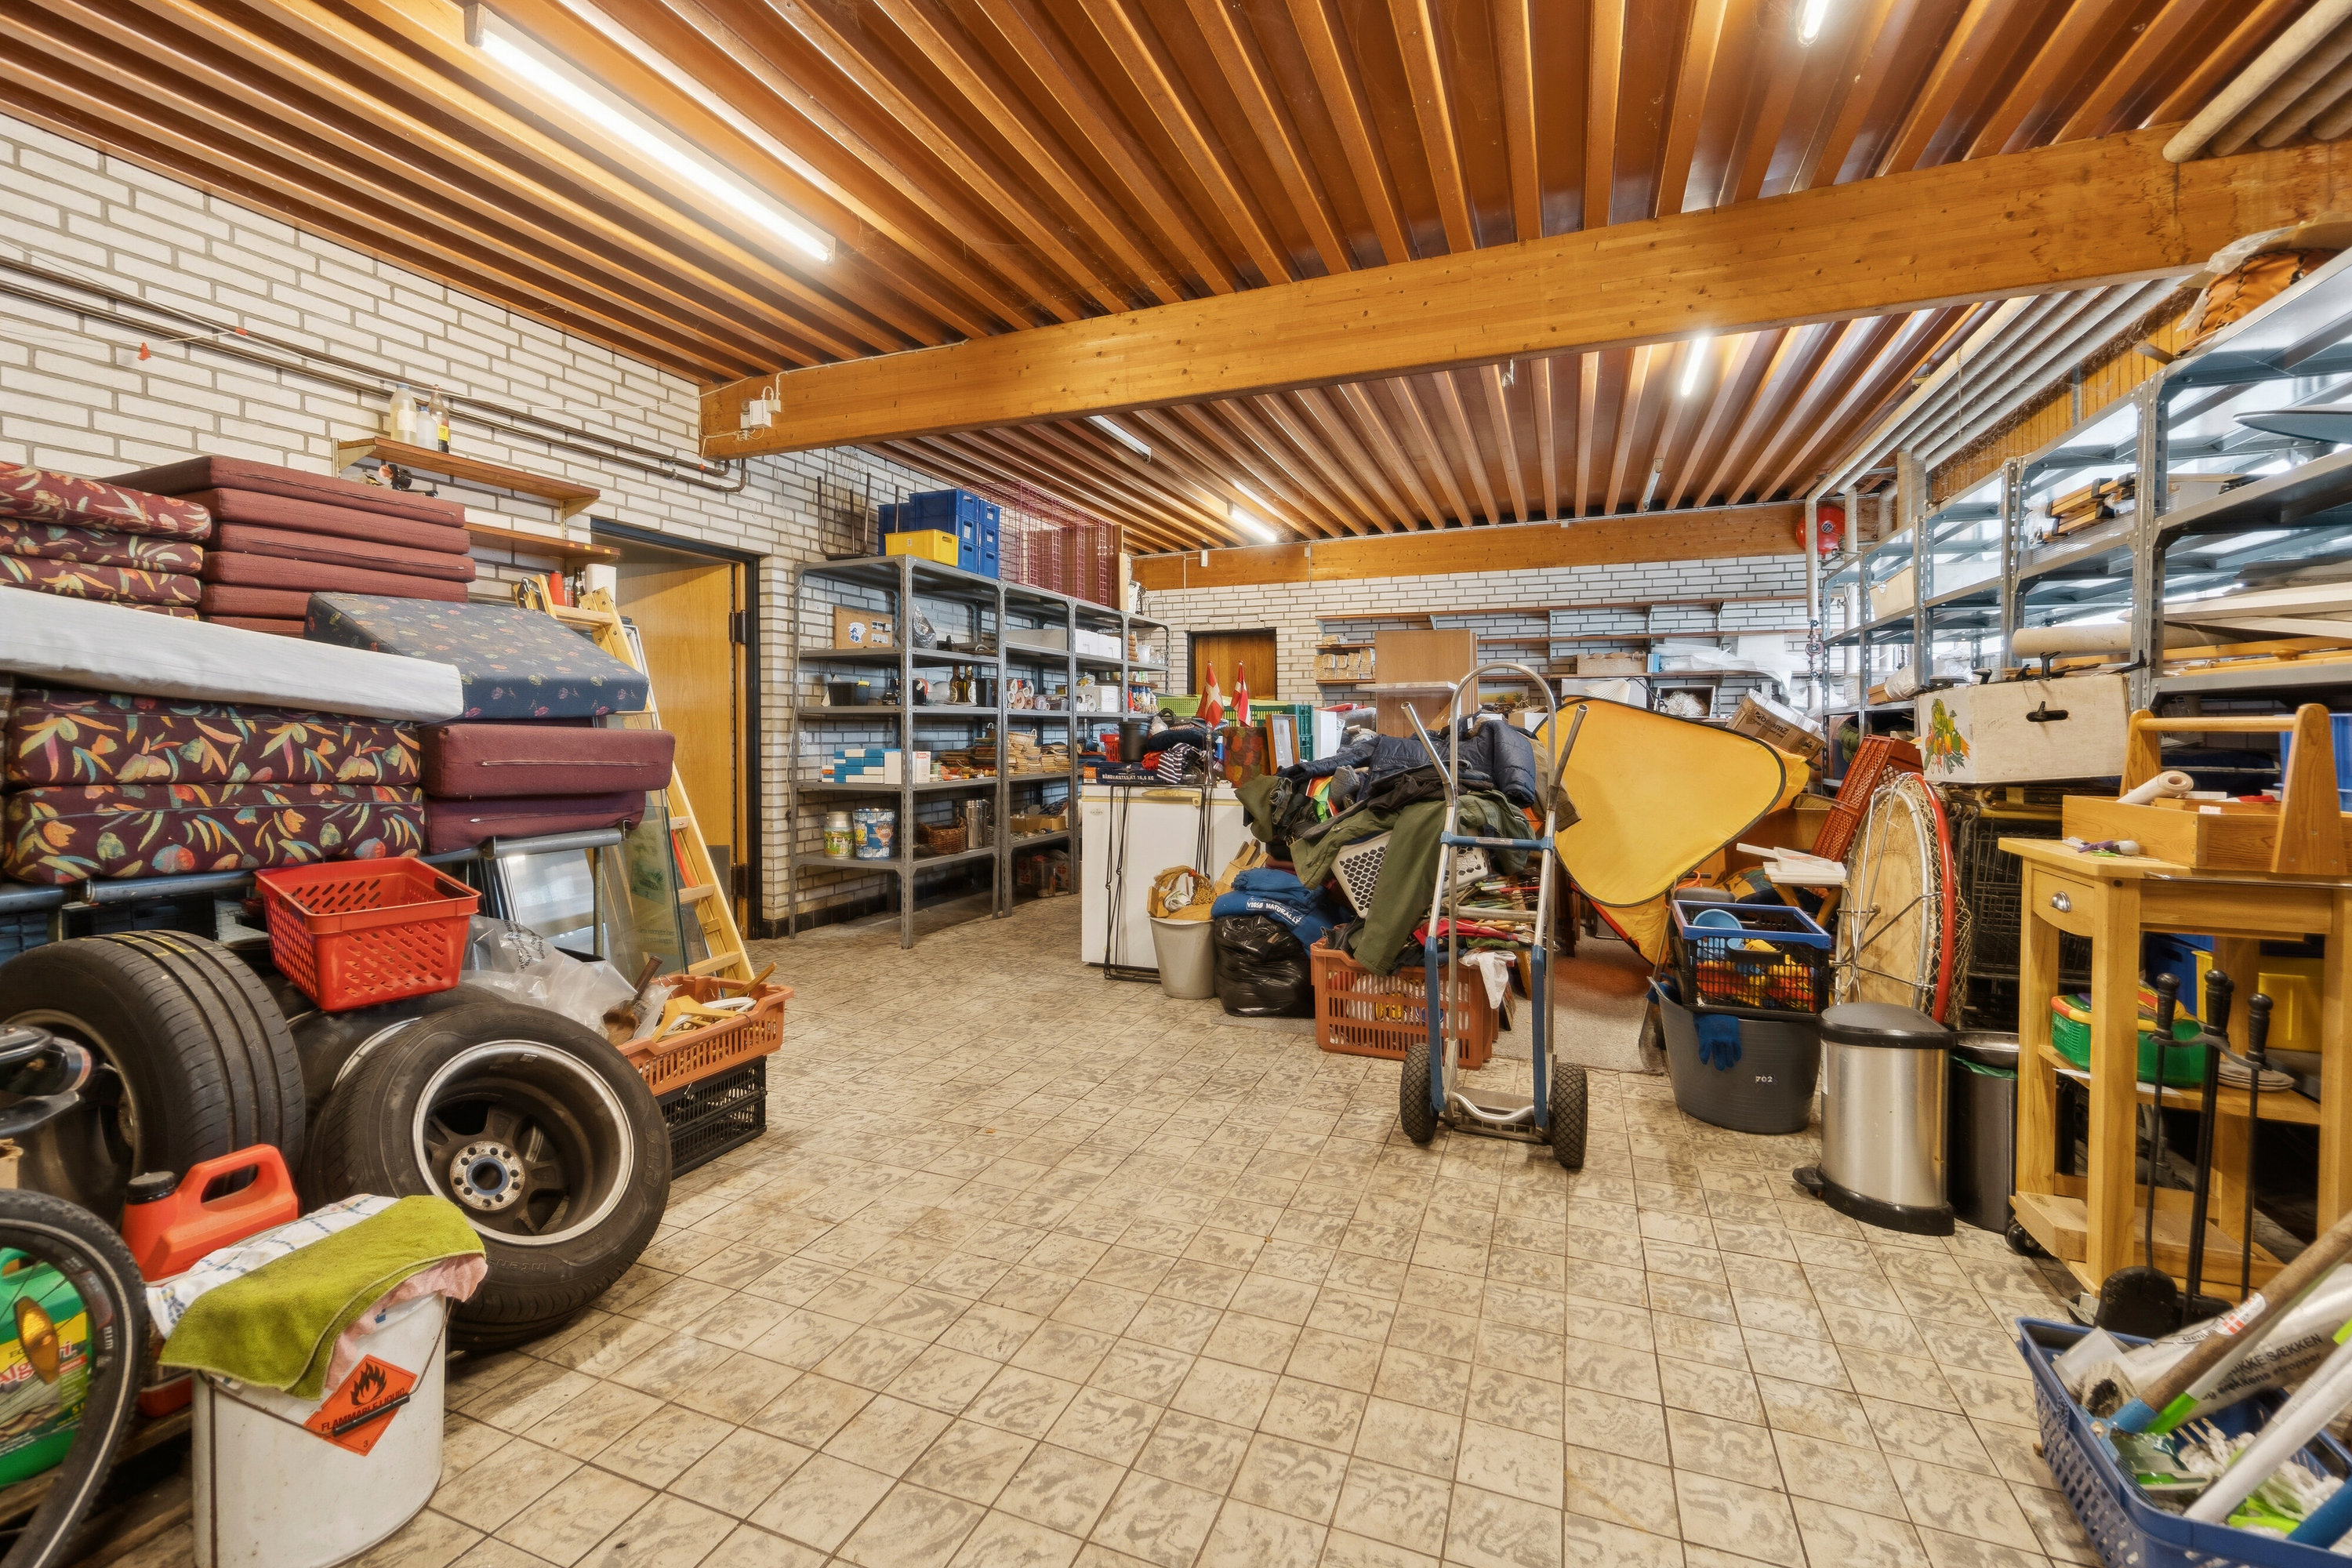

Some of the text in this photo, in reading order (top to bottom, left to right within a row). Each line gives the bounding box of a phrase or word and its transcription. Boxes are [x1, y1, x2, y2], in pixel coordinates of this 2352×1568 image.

[1265, 902, 1301, 924] NATURALLY
[2265, 1333, 2324, 1363] SÆKKEN
[363, 1439, 368, 1448] 3
